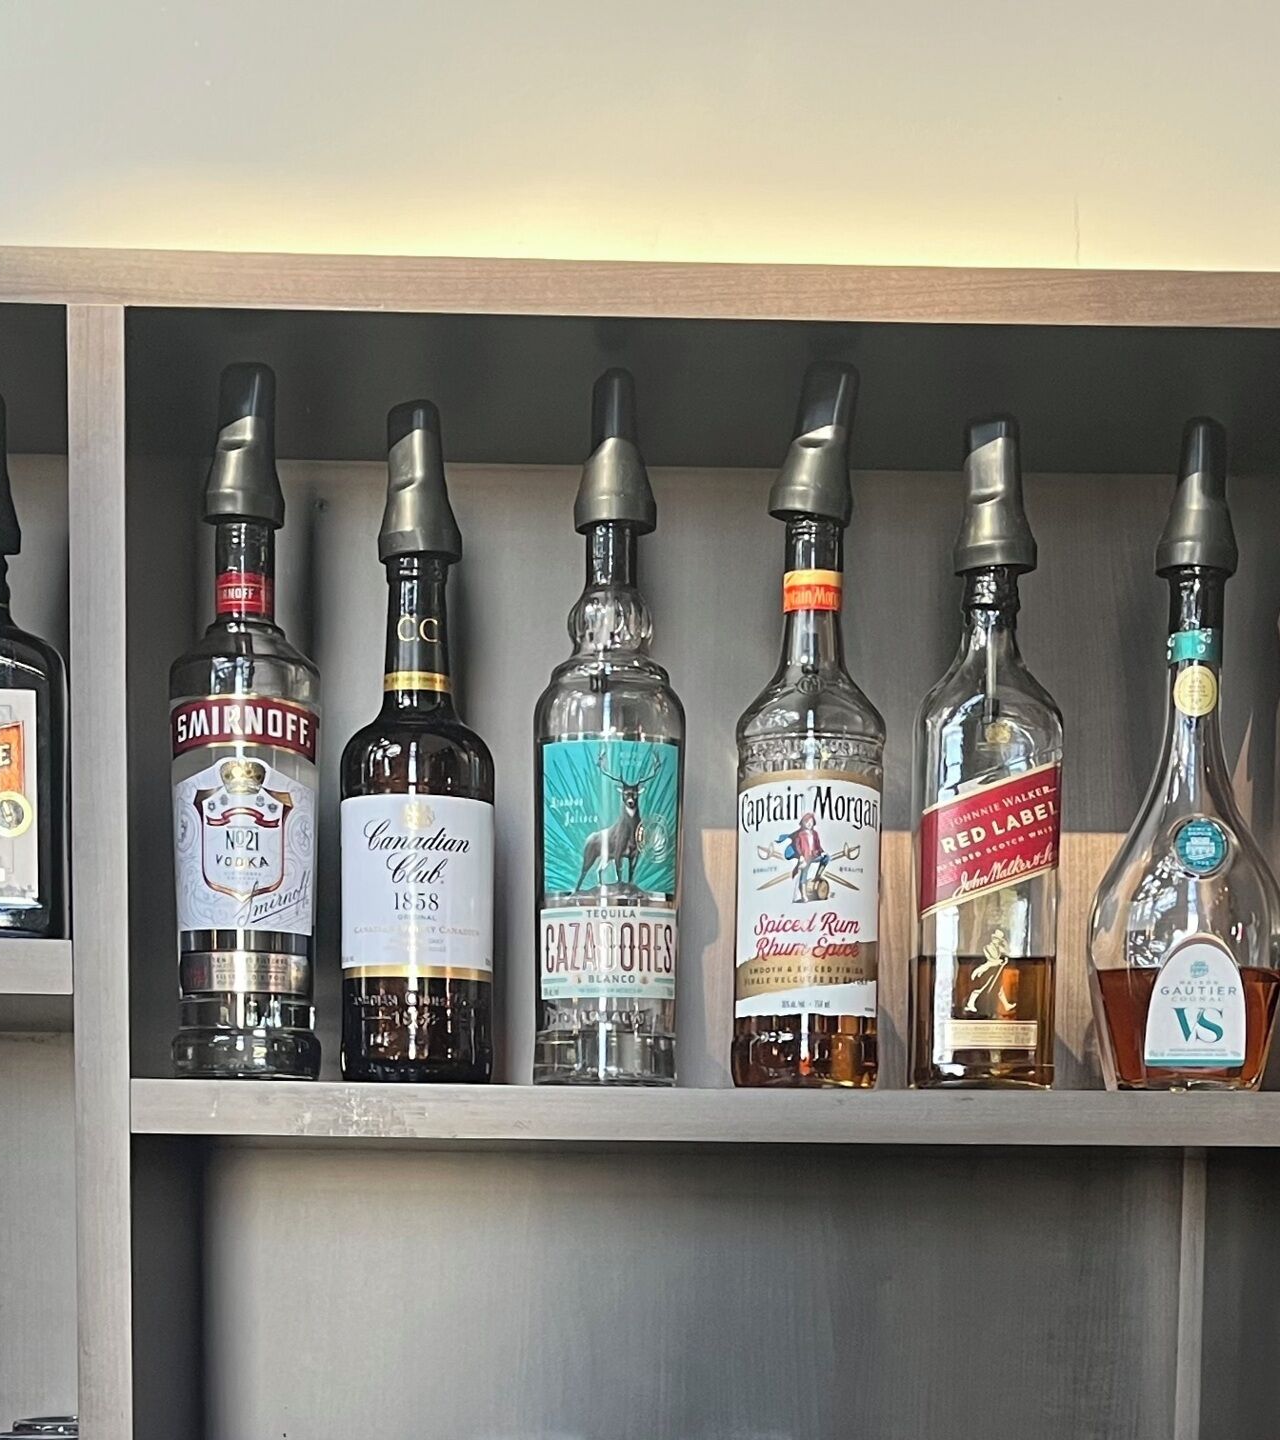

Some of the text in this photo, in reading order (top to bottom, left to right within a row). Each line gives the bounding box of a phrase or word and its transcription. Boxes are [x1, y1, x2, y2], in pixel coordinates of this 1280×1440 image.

[177, 704, 309, 746] SMIRNOFF
[808, 785, 880, 833] Morgan
[949, 785, 1052, 828] JOHNNIE WALKER
[363, 819, 471, 854] Canadian
[940, 800, 1057, 854] RED LABEL
[985, 836, 1025, 854] SCOTCH
[215, 853, 270, 869] VODKA
[233, 869, 312, 927] Smirnoff
[952, 870, 991, 899] John
[394, 892, 440, 911] 1858
[586, 909, 637, 919] TEQUILA
[754, 911, 861, 937] Spiced Rum
[546, 921, 673, 974] CAZADORES
[755, 937, 809, 961] Rhum
[588, 975, 636, 984] BLANCO
[749, 966, 783, 975] SMOOTH
[836, 966, 864, 974] FINISH
[1160, 986, 1237, 996] GAUTIER
[1173, 1007, 1224, 1044] VS
